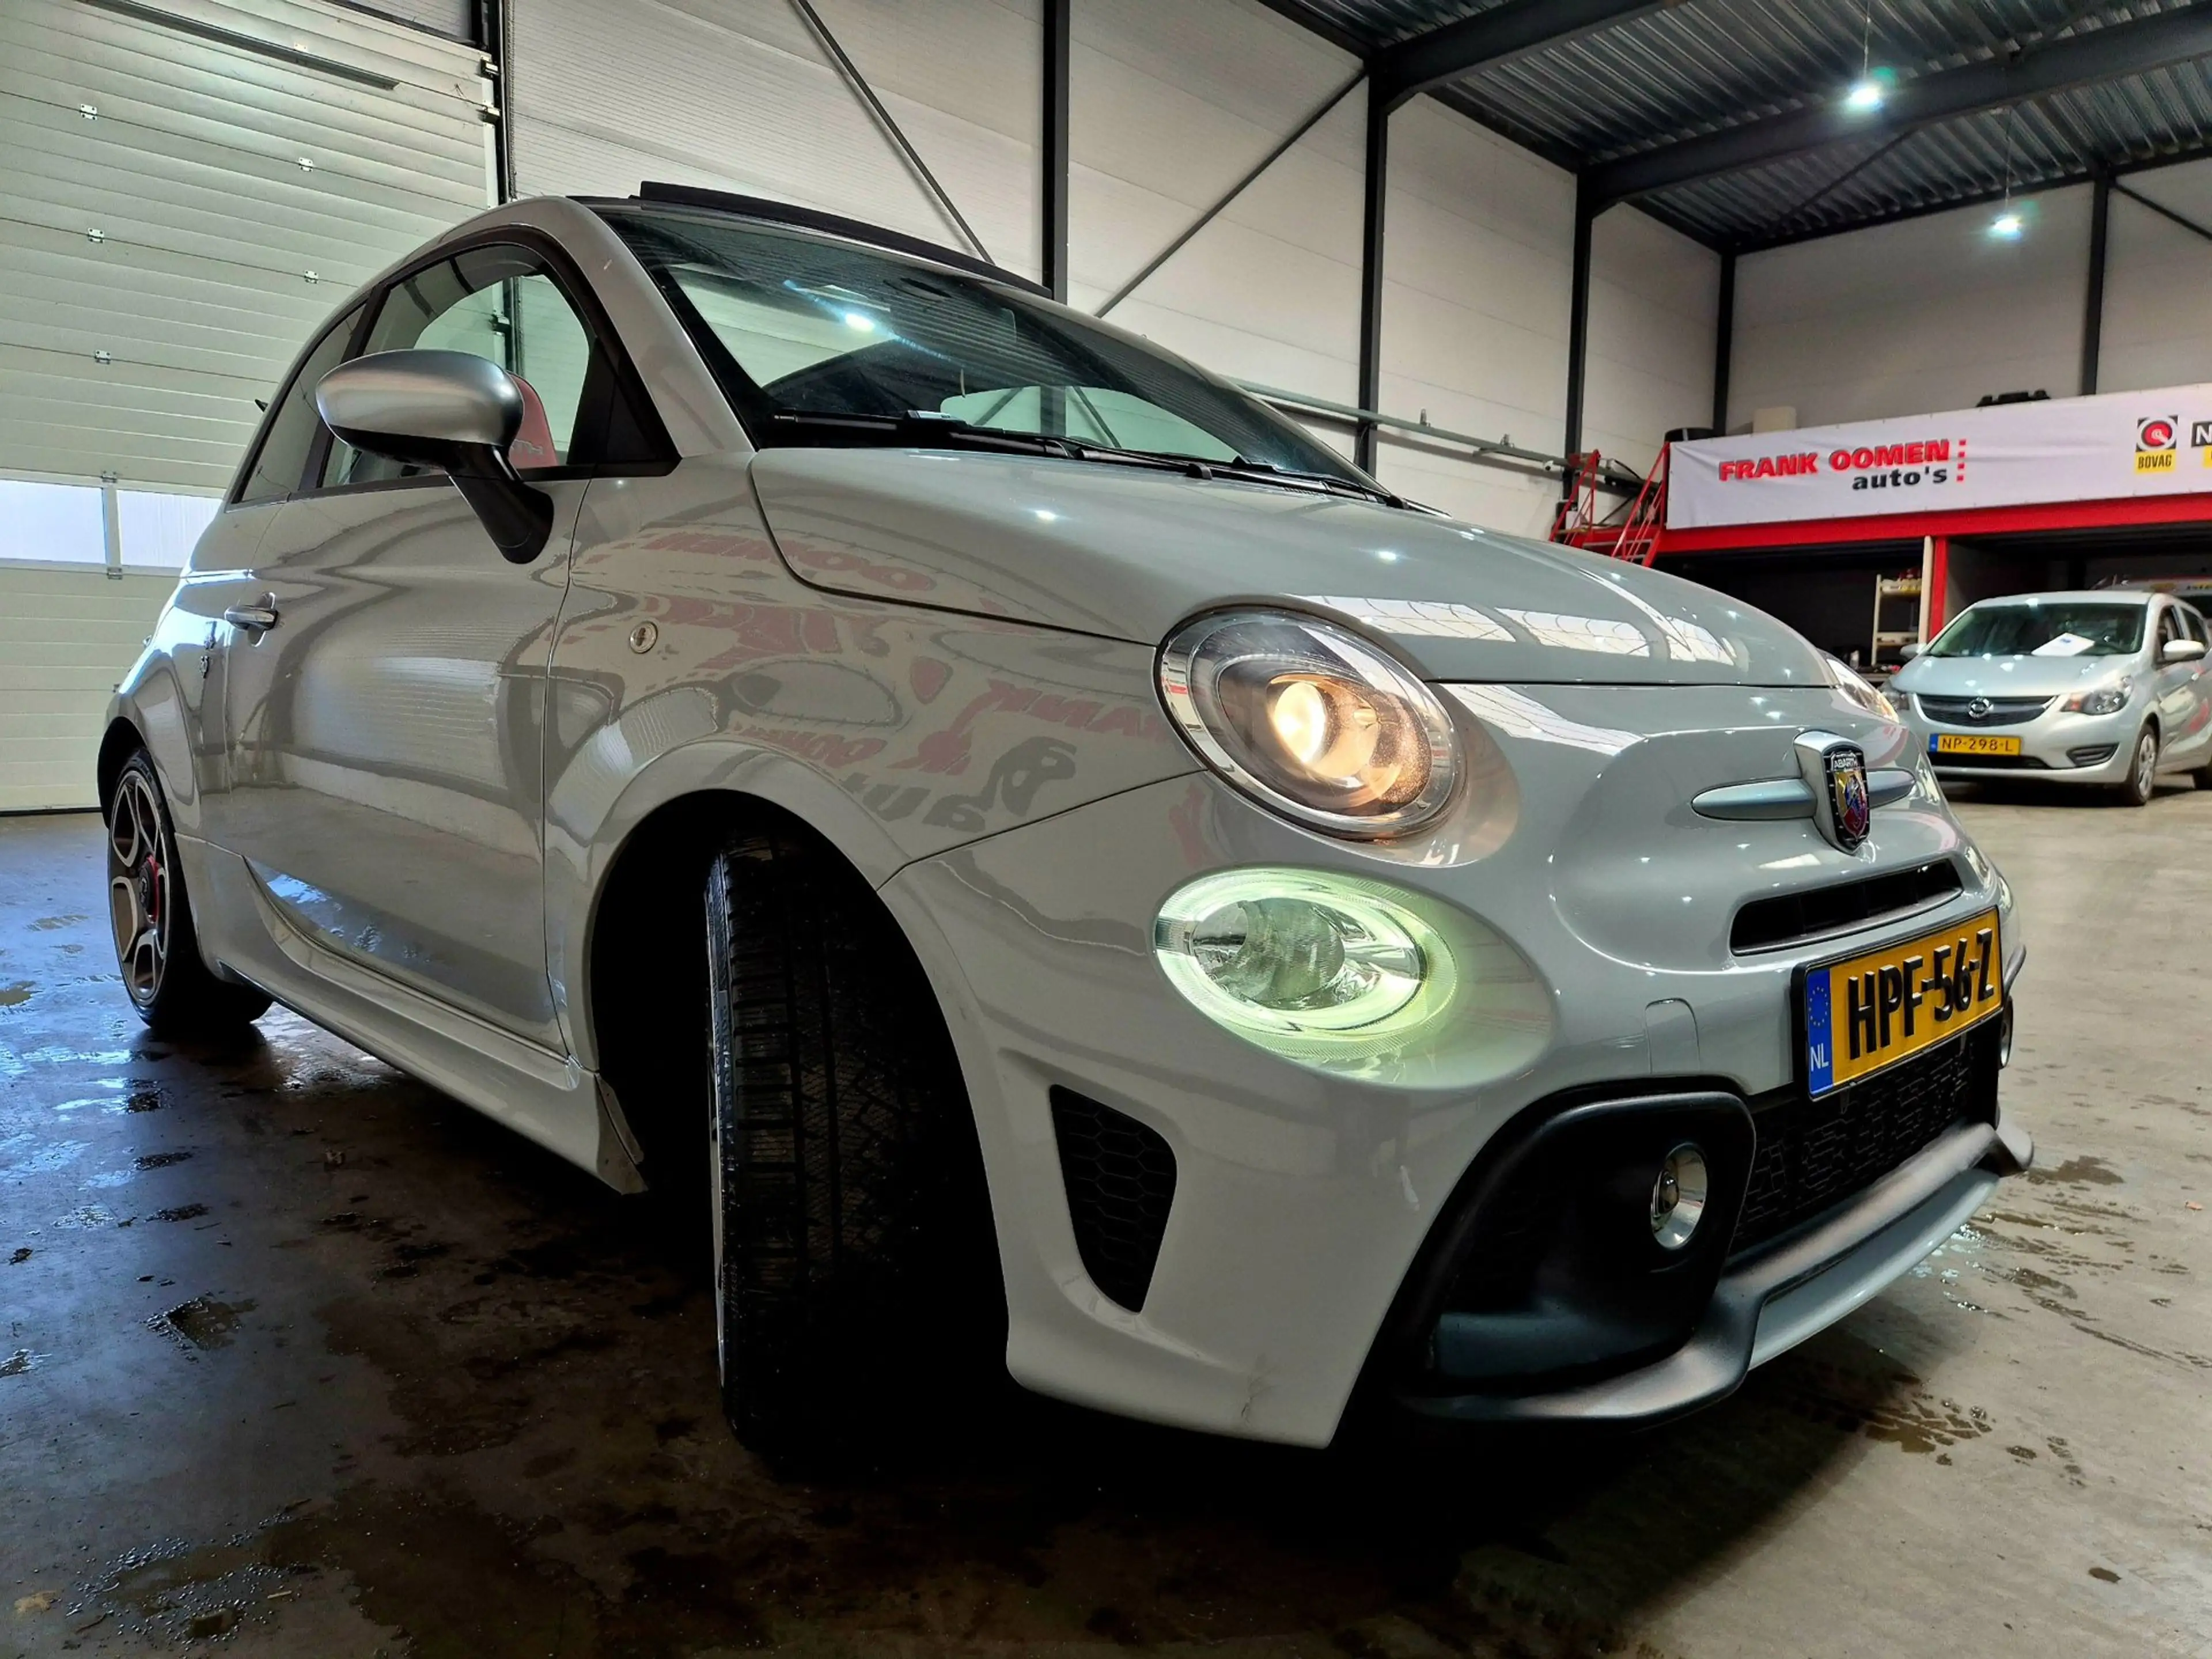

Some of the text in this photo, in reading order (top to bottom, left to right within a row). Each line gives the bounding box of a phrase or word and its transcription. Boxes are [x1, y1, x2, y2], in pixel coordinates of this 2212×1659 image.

[1719, 439, 1950, 481] FRANK OOMEN
[2138, 454, 2172, 469] BOVAG
[1852, 466, 1947, 490] auto's
[1942, 737, 2013, 752] NP-298-L
[1847, 927, 1995, 1060] HPF-56-Z
[1810, 1043, 1830, 1072] NL
